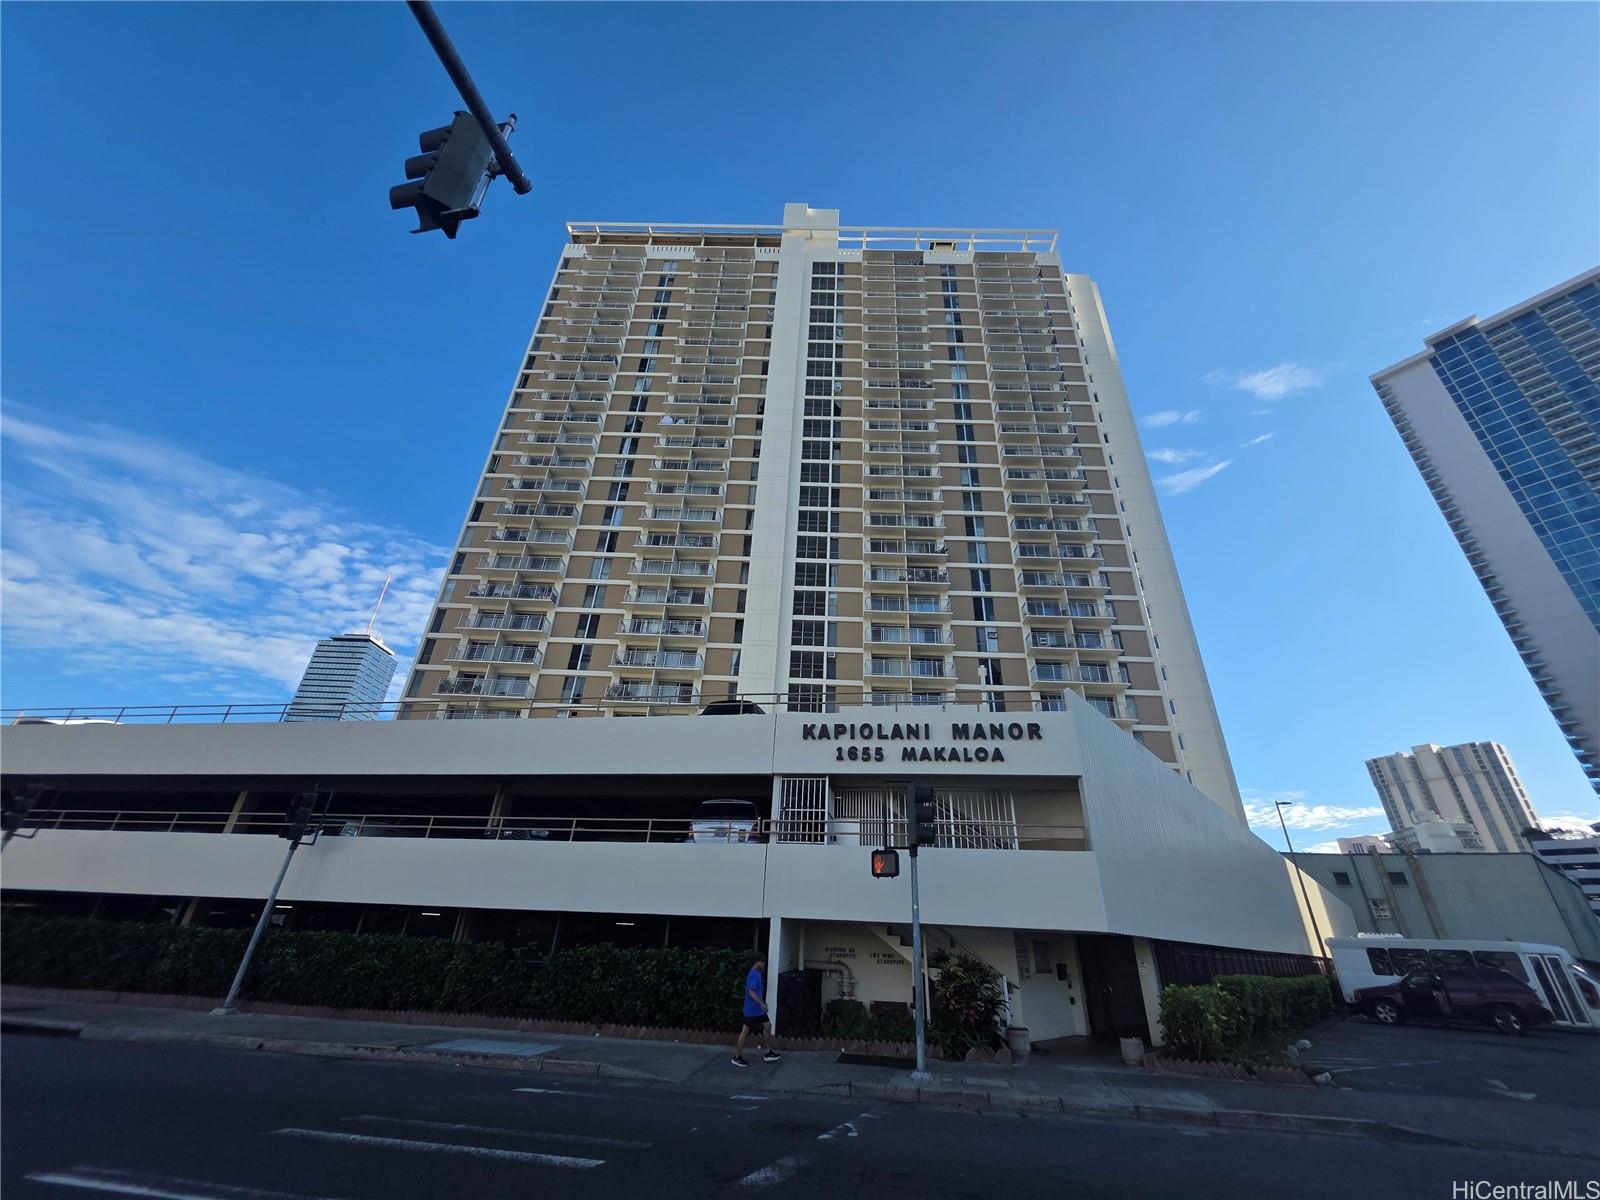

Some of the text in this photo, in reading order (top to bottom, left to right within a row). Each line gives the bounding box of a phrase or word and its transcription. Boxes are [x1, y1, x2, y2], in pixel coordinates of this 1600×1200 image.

[803, 723, 1042, 740] KAPIOLANI MANOR
[836, 746, 1004, 762] 1655 MAKALOA
